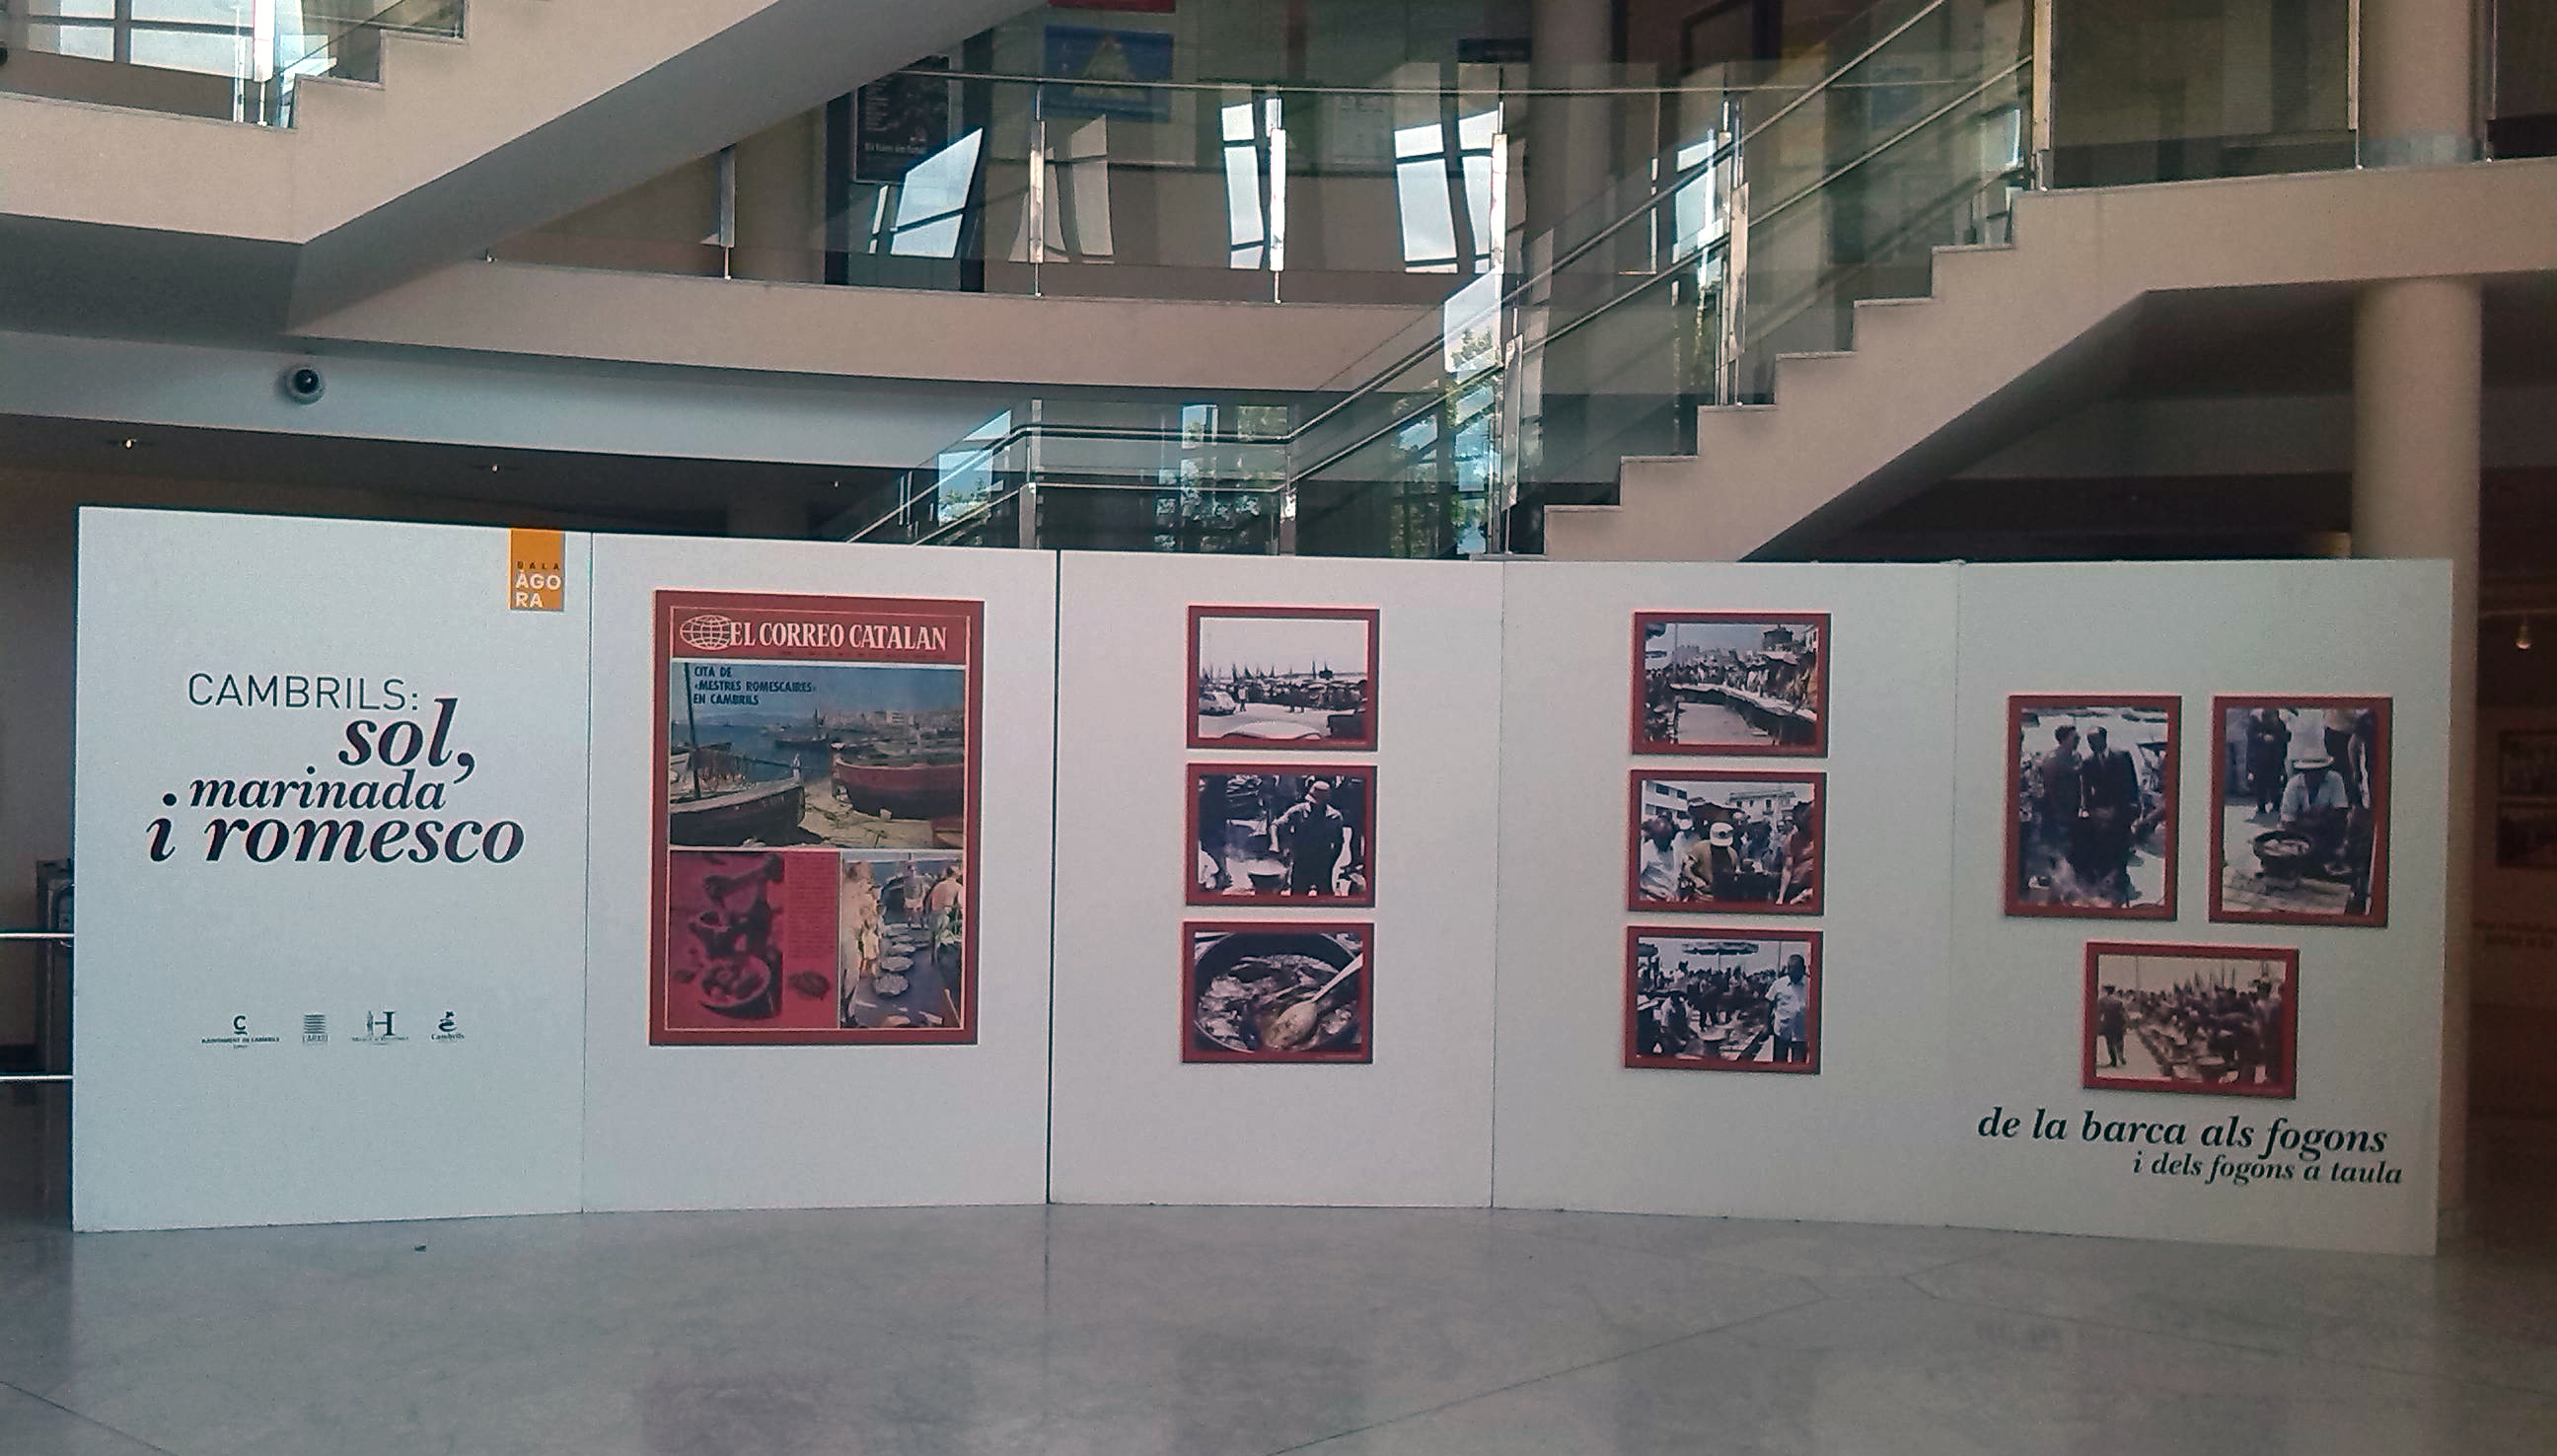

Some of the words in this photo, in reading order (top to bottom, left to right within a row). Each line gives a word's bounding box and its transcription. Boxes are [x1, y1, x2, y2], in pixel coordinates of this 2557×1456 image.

[516, 592, 544, 608] RA
[732, 621, 756, 647] EL
[759, 621, 845, 649] CORREO
[848, 622, 947, 651] CATALAN
[694, 666, 715, 677] CITA
[719, 666, 732, 678] DE
[188, 673, 419, 711] CAMBRILS:
[694, 692, 706, 704] EN
[710, 693, 760, 705] CAMBRILS
[338, 697, 476, 784] sol,
[189, 765, 446, 810] marinada
[146, 792, 179, 862] i
[204, 818, 525, 863] romesco
[1977, 1106, 2021, 1137] de
[2032, 1108, 2068, 1140] la
[2082, 1110, 2187, 1144] barca
[2200, 1115, 2255, 1148] als
[2257, 1117, 2388, 1162] fogons
[2133, 1150, 2144, 1174] i
[2151, 1152, 2203, 1176] dels
[2204, 1154, 2296, 1185] fogons
[2302, 1164, 2321, 1181] a
[2330, 1160, 2403, 1184] taula
